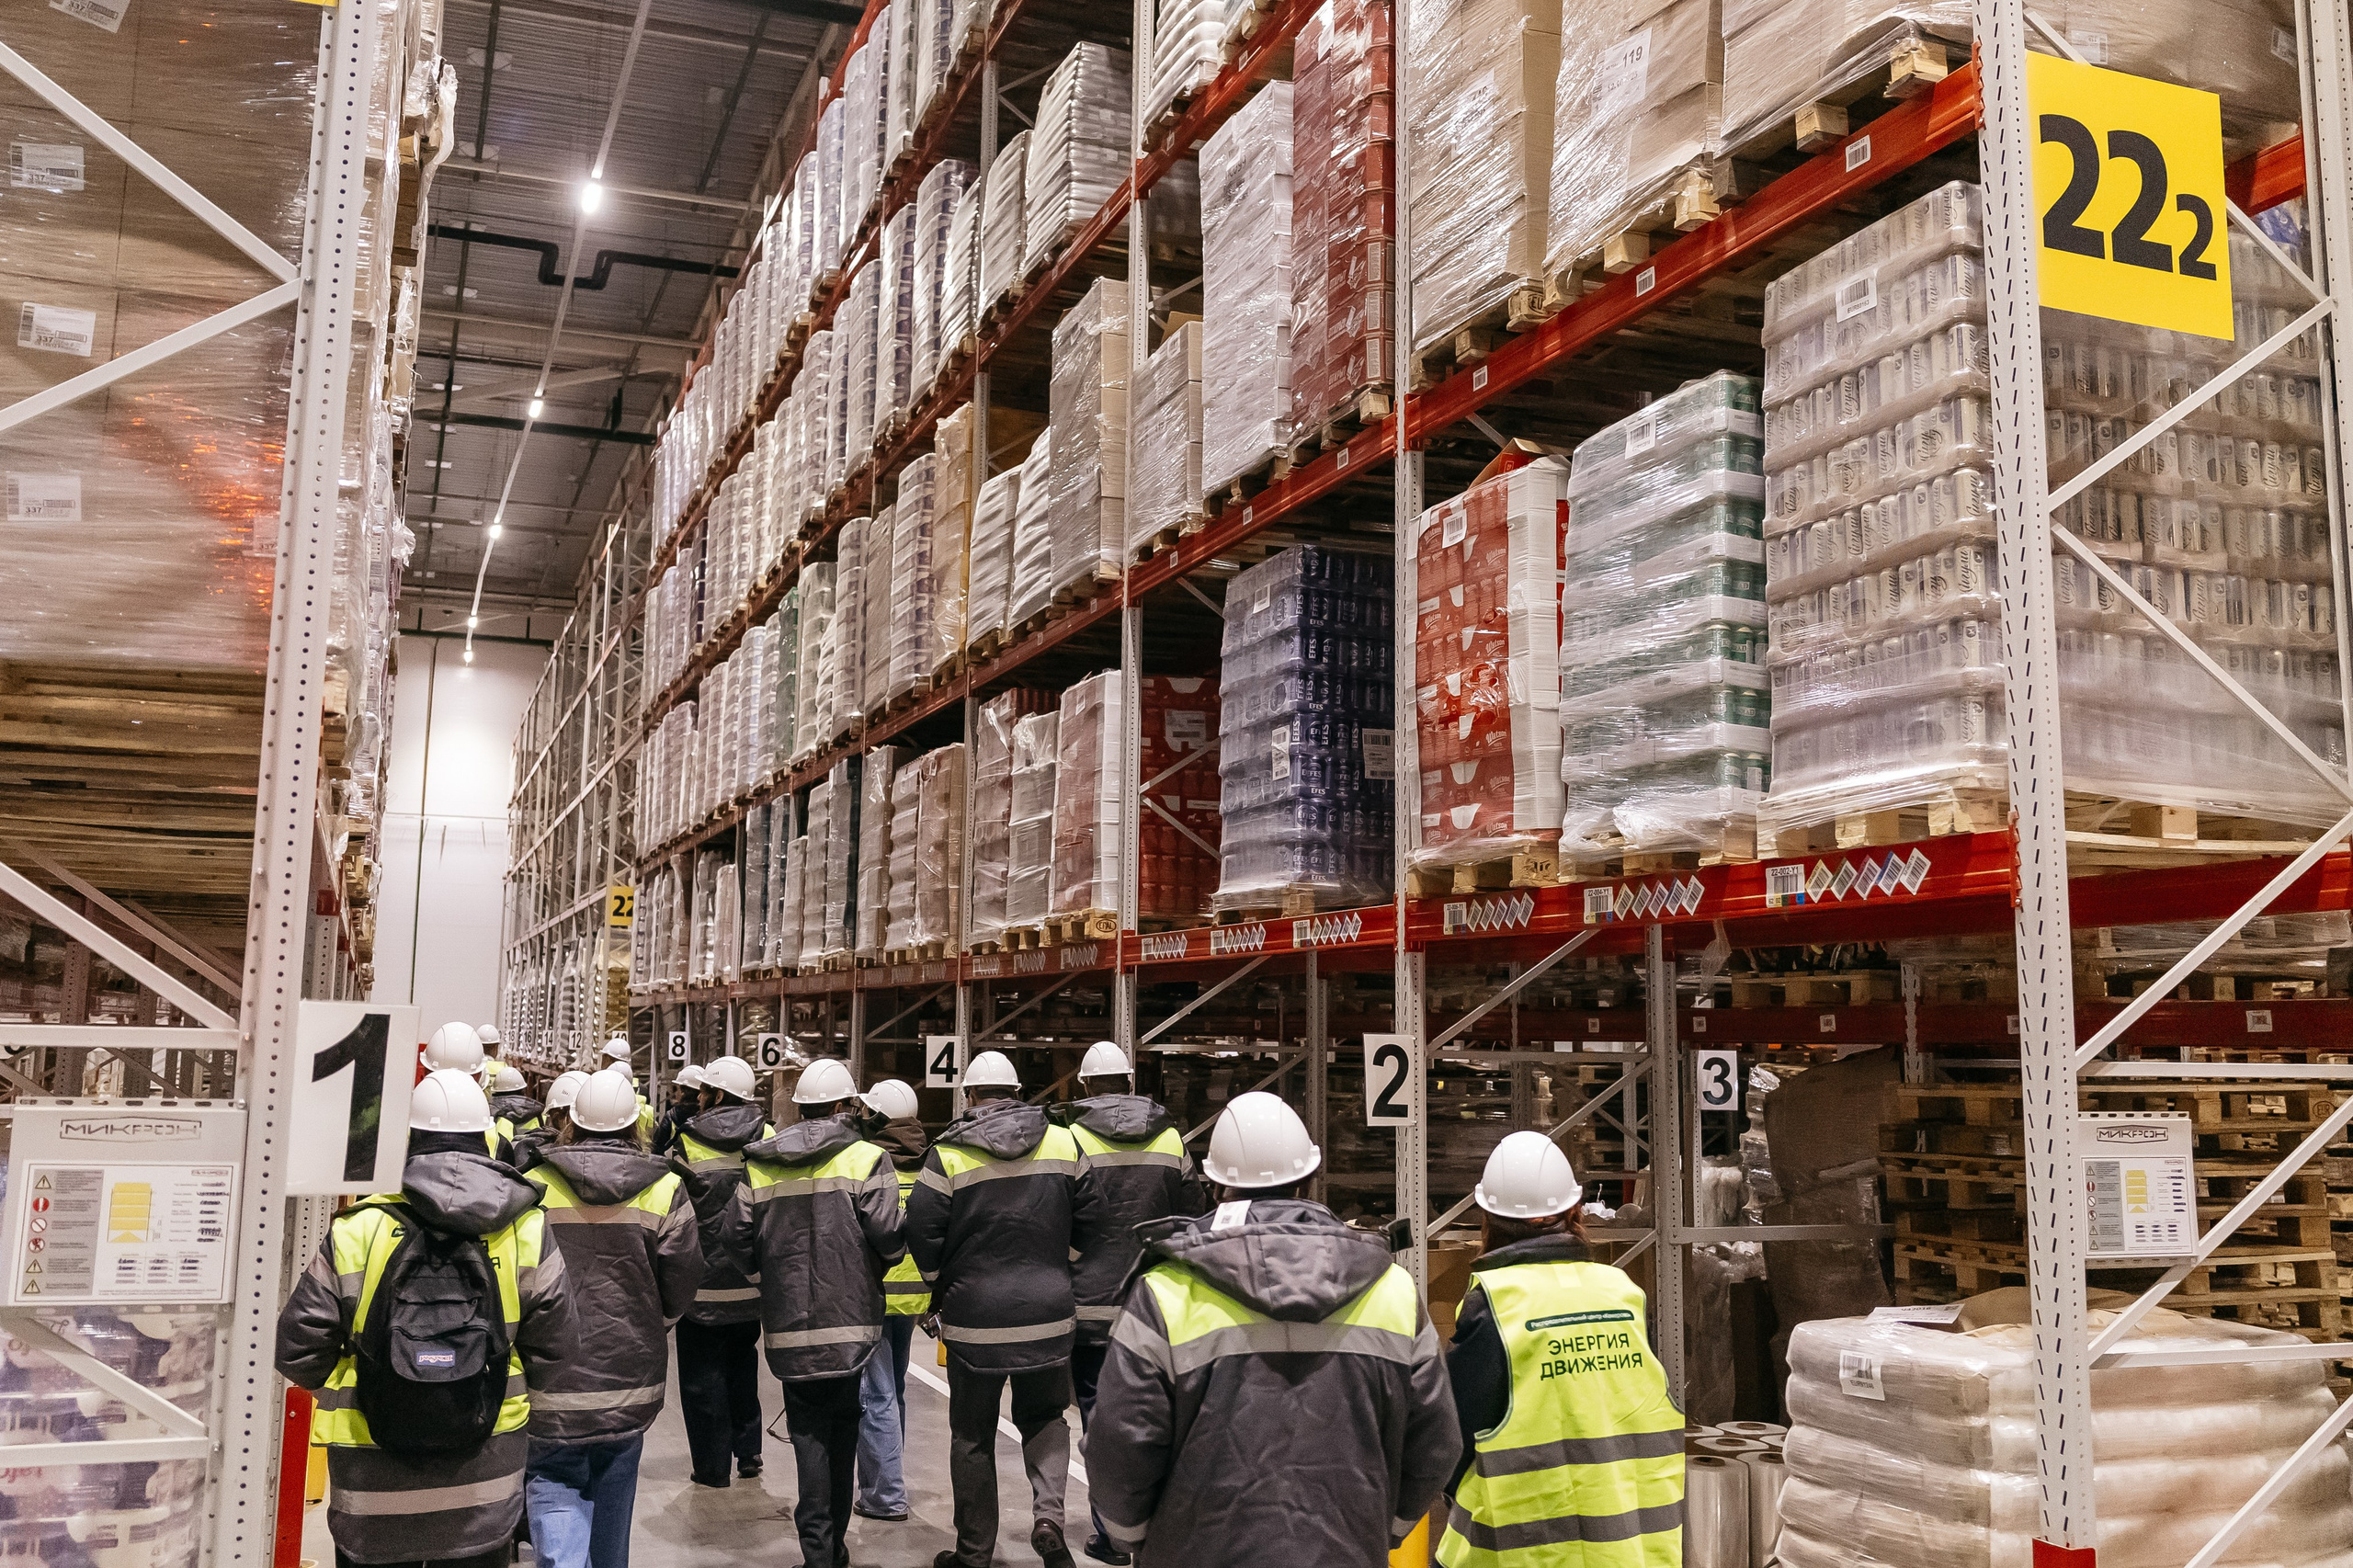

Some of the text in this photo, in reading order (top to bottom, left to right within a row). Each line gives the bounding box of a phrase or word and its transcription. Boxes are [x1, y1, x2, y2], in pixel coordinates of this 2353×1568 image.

[1623, 46, 1643, 67] 119
[1530, 296, 1545, 310] EU
[1486, 731, 1507, 744] Watson
[1771, 867, 1799, 877] 22-002-Y1
[1587, 888, 1609, 897] 22-004-Y1
[508, 1030, 515, 1042] 18
[524, 1030, 532, 1043] 16
[544, 1031, 553, 1045] 14
[571, 1032, 581, 1048] 12
[672, 1035, 685, 1057] 8
[762, 1038, 780, 1066] 6
[930, 1041, 958, 1083] 4
[1372, 1044, 1409, 1118] 2
[1702, 1057, 1733, 1105] 3
[312, 1014, 391, 1181] 1
[2098, 1131, 2166, 1139] МИКРОН
[1548, 1333, 1630, 1355] ЭНЕРГИЯ
[1540, 1353, 1643, 1381] ДВИЖЕНИЯ
